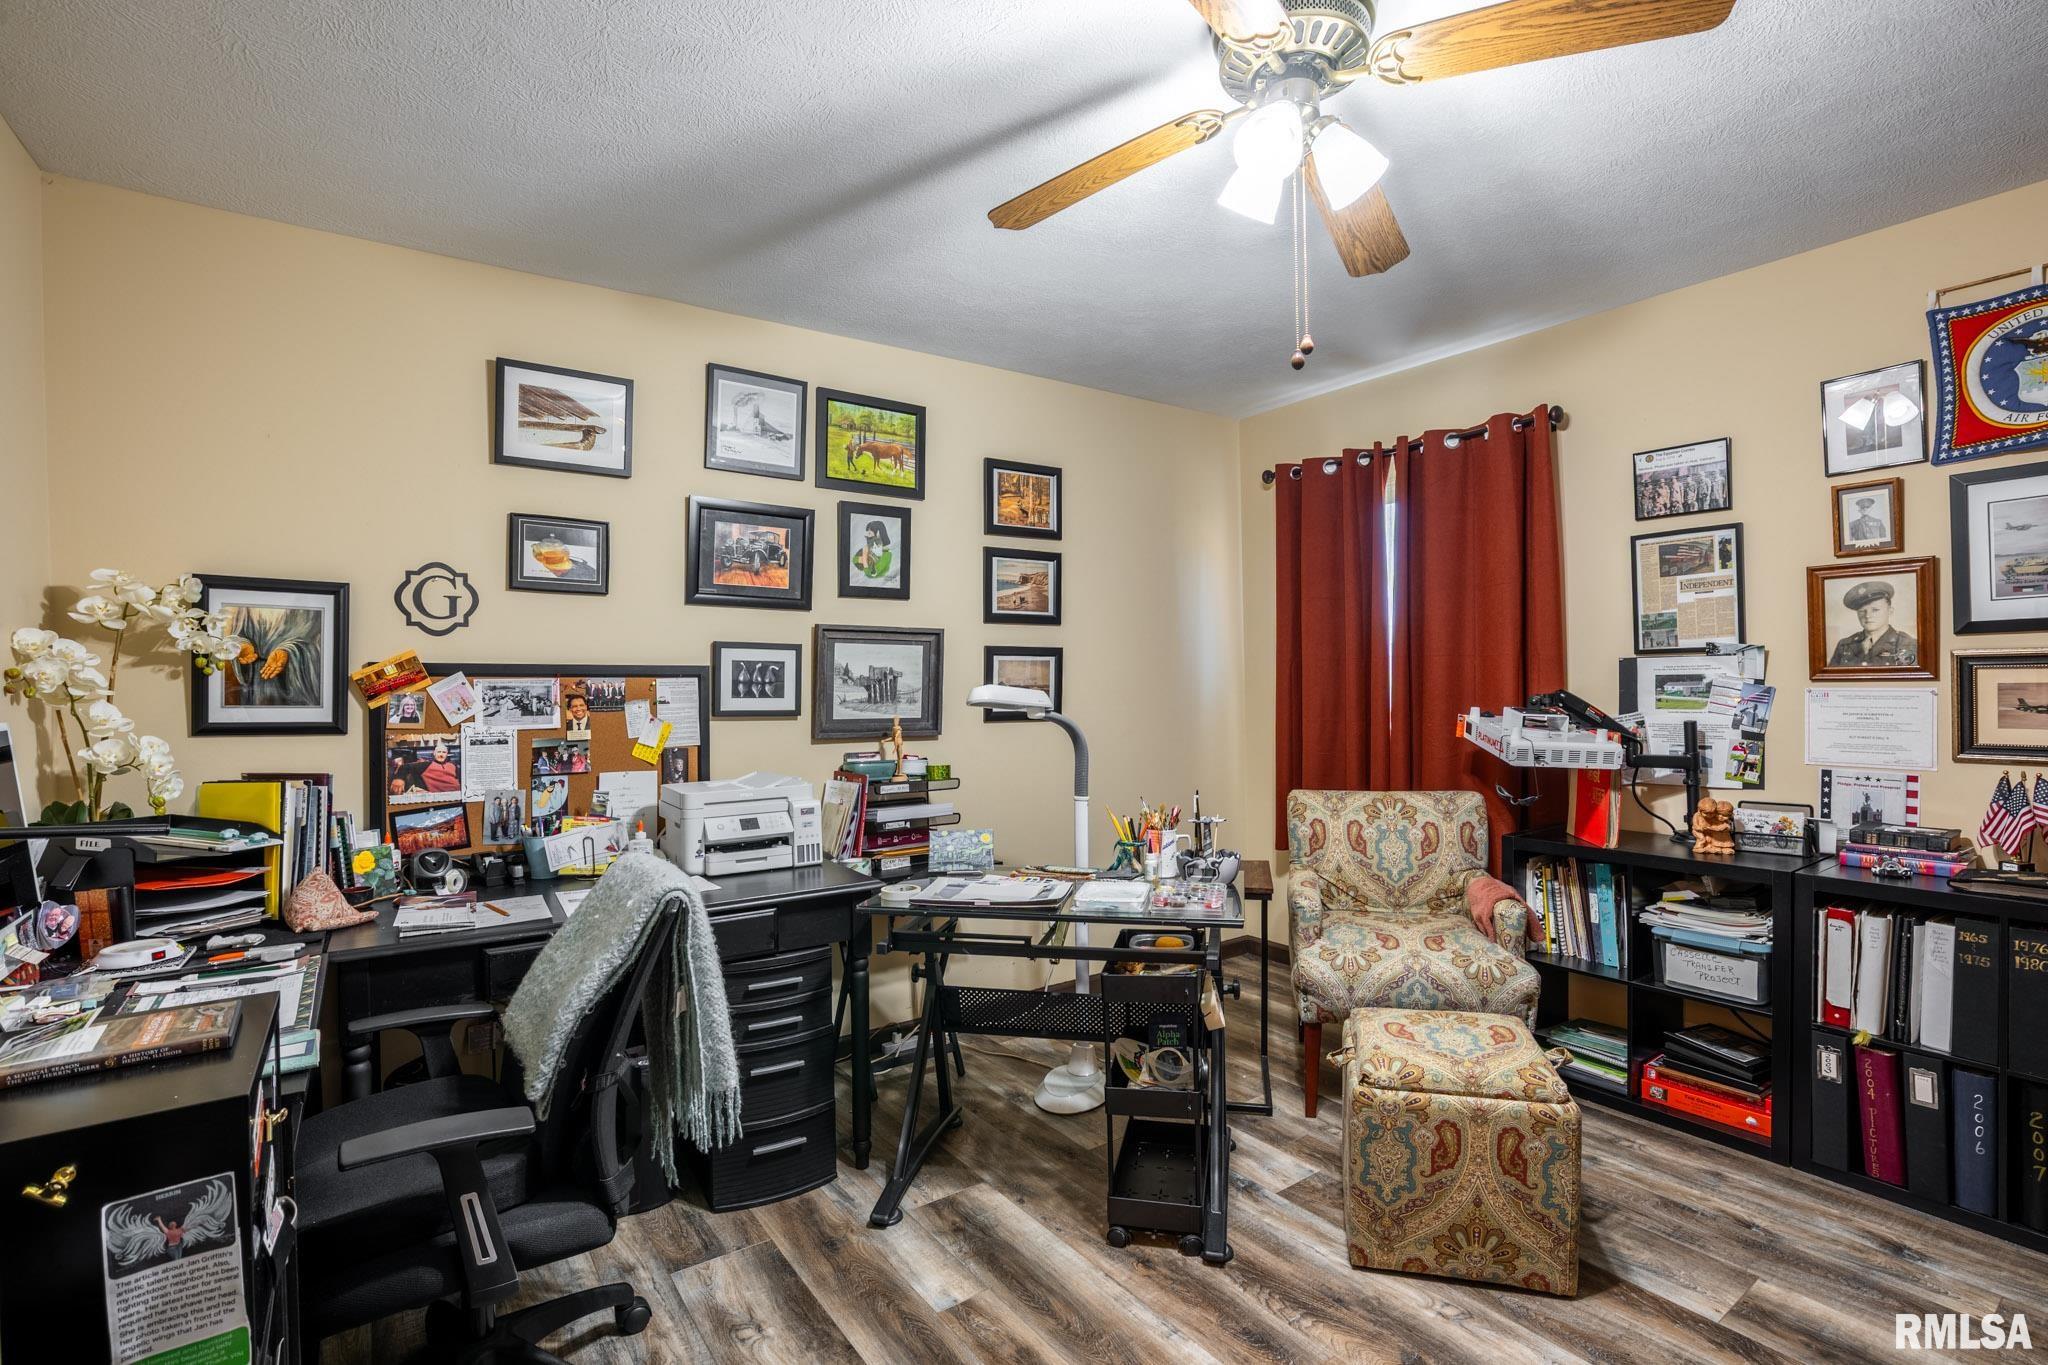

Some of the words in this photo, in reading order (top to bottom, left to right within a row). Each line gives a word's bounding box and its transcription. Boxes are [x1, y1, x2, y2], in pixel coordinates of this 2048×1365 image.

[1987, 308, 2044, 339] UNITED
[2003, 413, 2030, 423] AIR
[412, 575, 462, 619] G
[1680, 578, 1734, 591] INDEPENDENT
[80, 840, 102, 848] FILE
[1958, 931, 1989, 944] 1965
[2014, 939, 2048, 955] 1976
[1683, 960, 1736, 976] TRANSFER
[1958, 953, 1991, 968] 1975
[1157, 1030, 1181, 1039] Alpha
[1157, 1038, 1179, 1046] Patch
[129, 1048, 158, 1059] HISTORY
[153, 1049, 182, 1059] ILLINOIS
[14, 1068, 49, 1079] MAGICAL
[51, 1062, 81, 1072] SEASON
[42, 1069, 72, 1079] HERRIN
[73, 1063, 100, 1073] TIGERS
[1864, 1058, 1876, 1100] 2004
[1973, 1094, 1986, 1155] 2006
[1868, 1107, 1881, 1179] PICTURES
[2029, 1111, 2047, 1182] 2007
[116, 1280, 132, 1290] The
[133, 1271, 159, 1284] article
[161, 1263, 184, 1275] about
[186, 1258, 200, 1268] Jan
[116, 1283, 144, 1298] artistic
[147, 1275, 169, 1287] talent
[172, 1271, 187, 1280] was
[131, 1284, 168, 1300] nextdoor
[170, 1274, 204, 1289] neighbor
[206, 1269, 219, 1279] has
[221, 1265, 239, 1275] been
[117, 1297, 149, 1314] fighting
[151, 1290, 172, 1302] brain
[173, 1284, 199, 1296] cancer
[201, 1280, 212, 1288] for
[213, 1273, 240, 1286] several
[145, 1303, 159, 1313] Her
[161, 1296, 183, 1307] latest
[185, 1286, 222, 1300] treatment
[118, 1313, 153, 1330] required
[155, 1307, 169, 1317] her
[180, 1299, 202, 1310] shave
[204, 1294, 217, 1303] her
[120, 1327, 136, 1338] She
[146, 1312, 189, 1329] embracing
[190, 1306, 204, 1316] this
[206, 1301, 220, 1311] and
[222, 1297, 236, 1307] had
[120, 1337, 134, 1346] her
[135, 1328, 159, 1342] photo
[161, 1323, 182, 1335] taken
[193, 1312, 211, 1324] front
[223, 1306, 236, 1316] the
[120, 1340, 151, 1355] angelic
[152, 1331, 176, 1344] wings
[176, 1325, 192, 1336] that
[194, 1321, 208, 1332] Jan
[209, 1318, 224, 1328] has
